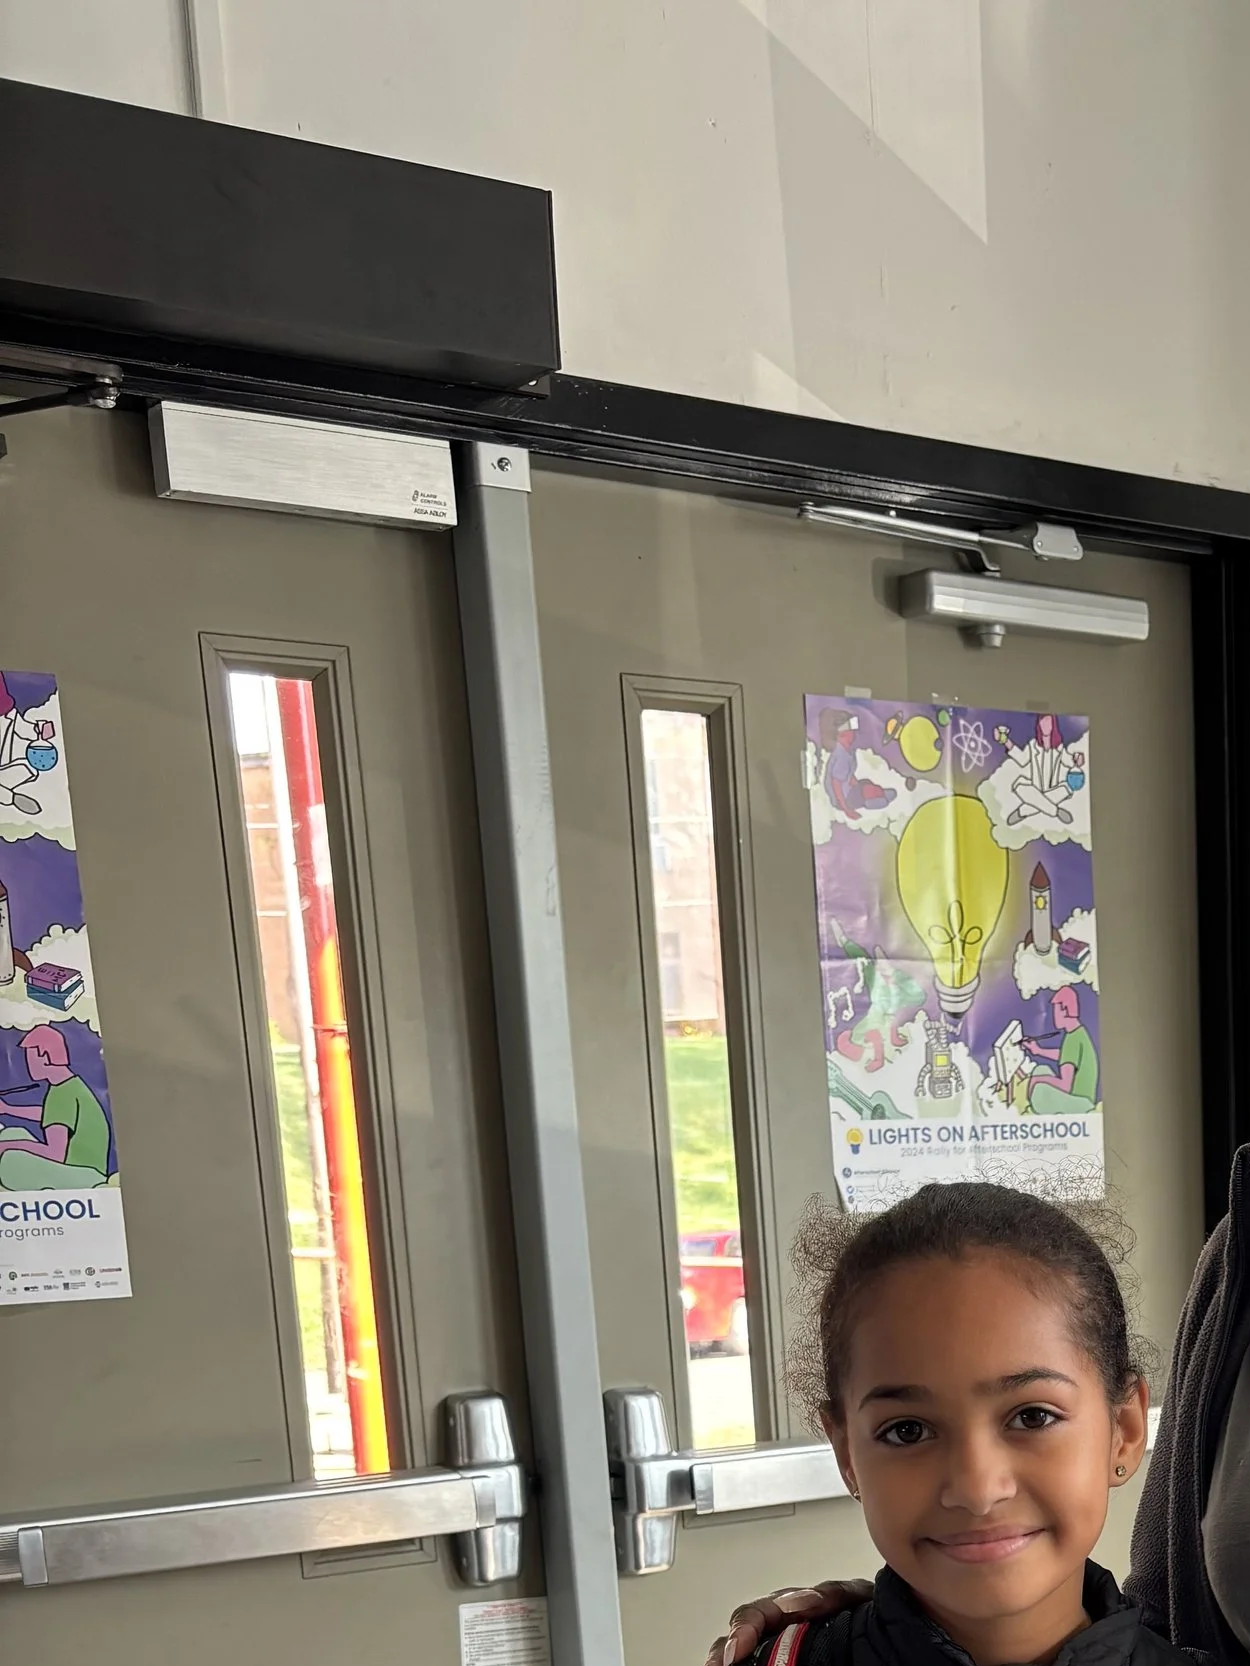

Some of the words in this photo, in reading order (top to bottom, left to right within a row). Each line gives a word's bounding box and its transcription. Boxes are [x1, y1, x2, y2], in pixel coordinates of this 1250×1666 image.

[869, 1127, 932, 1145] LIGHTS
[937, 1126, 964, 1143] ON
[968, 1121, 1090, 1143] AFTERSCHOOL
[1023, 1142, 1068, 1154] Programs
